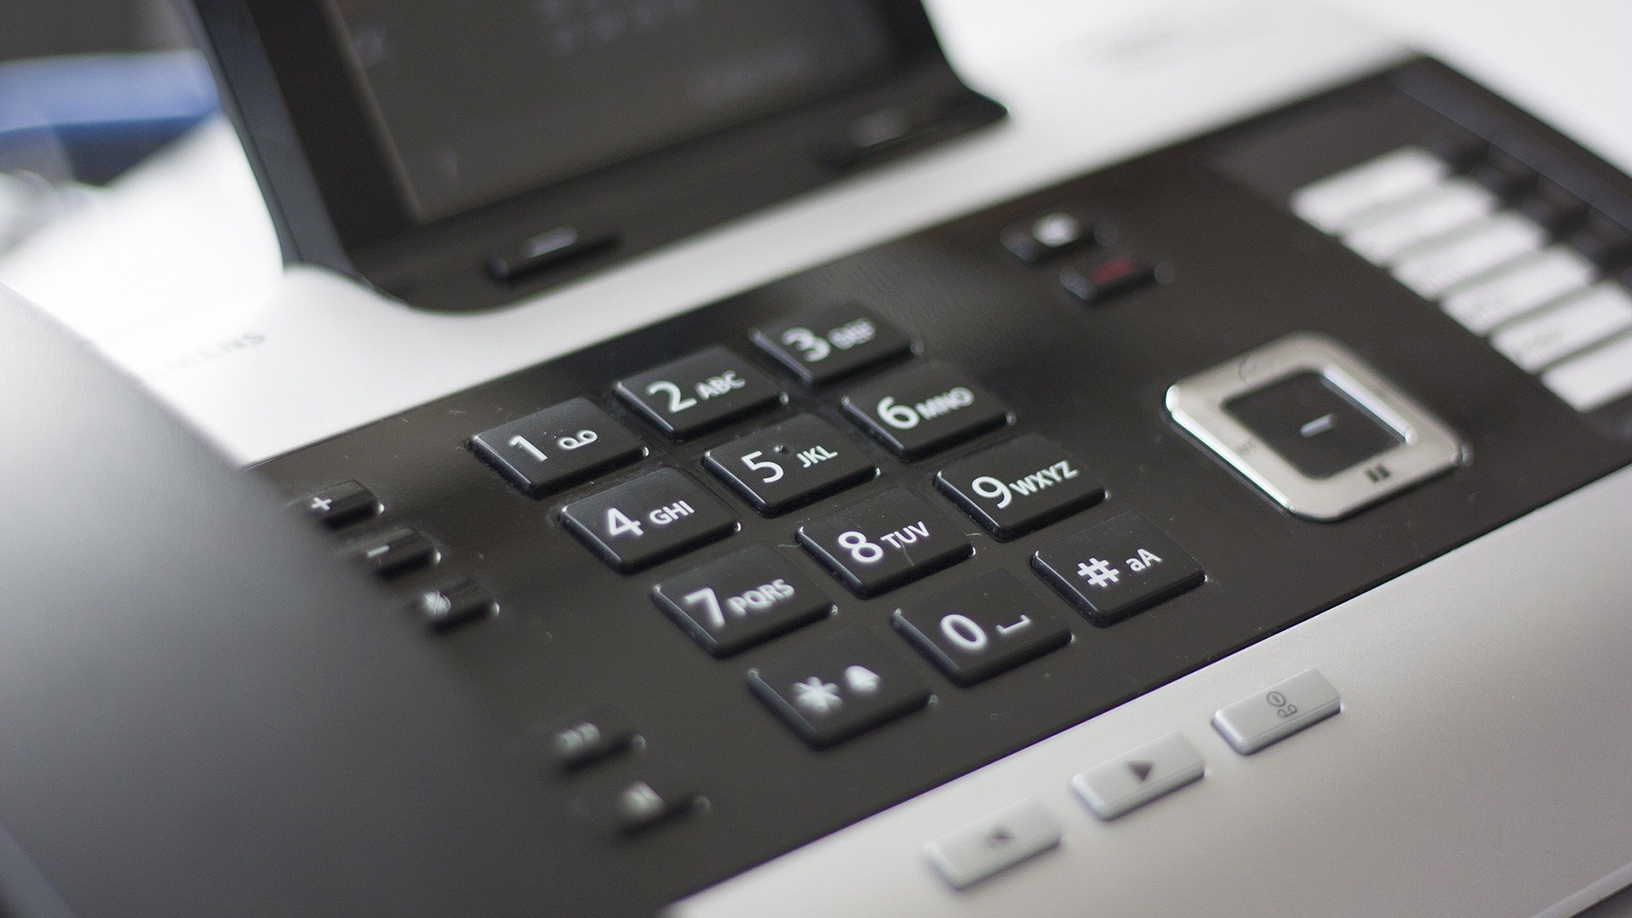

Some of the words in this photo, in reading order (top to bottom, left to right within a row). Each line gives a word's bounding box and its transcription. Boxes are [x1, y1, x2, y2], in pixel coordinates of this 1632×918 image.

[781, 327, 832, 362] 3
[647, 380, 697, 413] 2
[695, 369, 746, 400] ABC
[876, 395, 921, 430] 6
[915, 386, 975, 421] MNO
[509, 435, 548, 462] 1
[741, 451, 784, 483] 5
[797, 445, 838, 468] JKL
[971, 475, 1012, 508] 9
[1008, 460, 1079, 496] WXYZ
[607, 507, 644, 537] 4
[649, 500, 695, 525] GHI
[837, 530, 883, 563] 8
[880, 521, 930, 549] TUV
[1077, 557, 1120, 588] #
[1125, 548, 1163, 572] aA
[682, 586, 725, 628] 7
[727, 578, 795, 617] PQRS
[940, 613, 988, 651] 0
